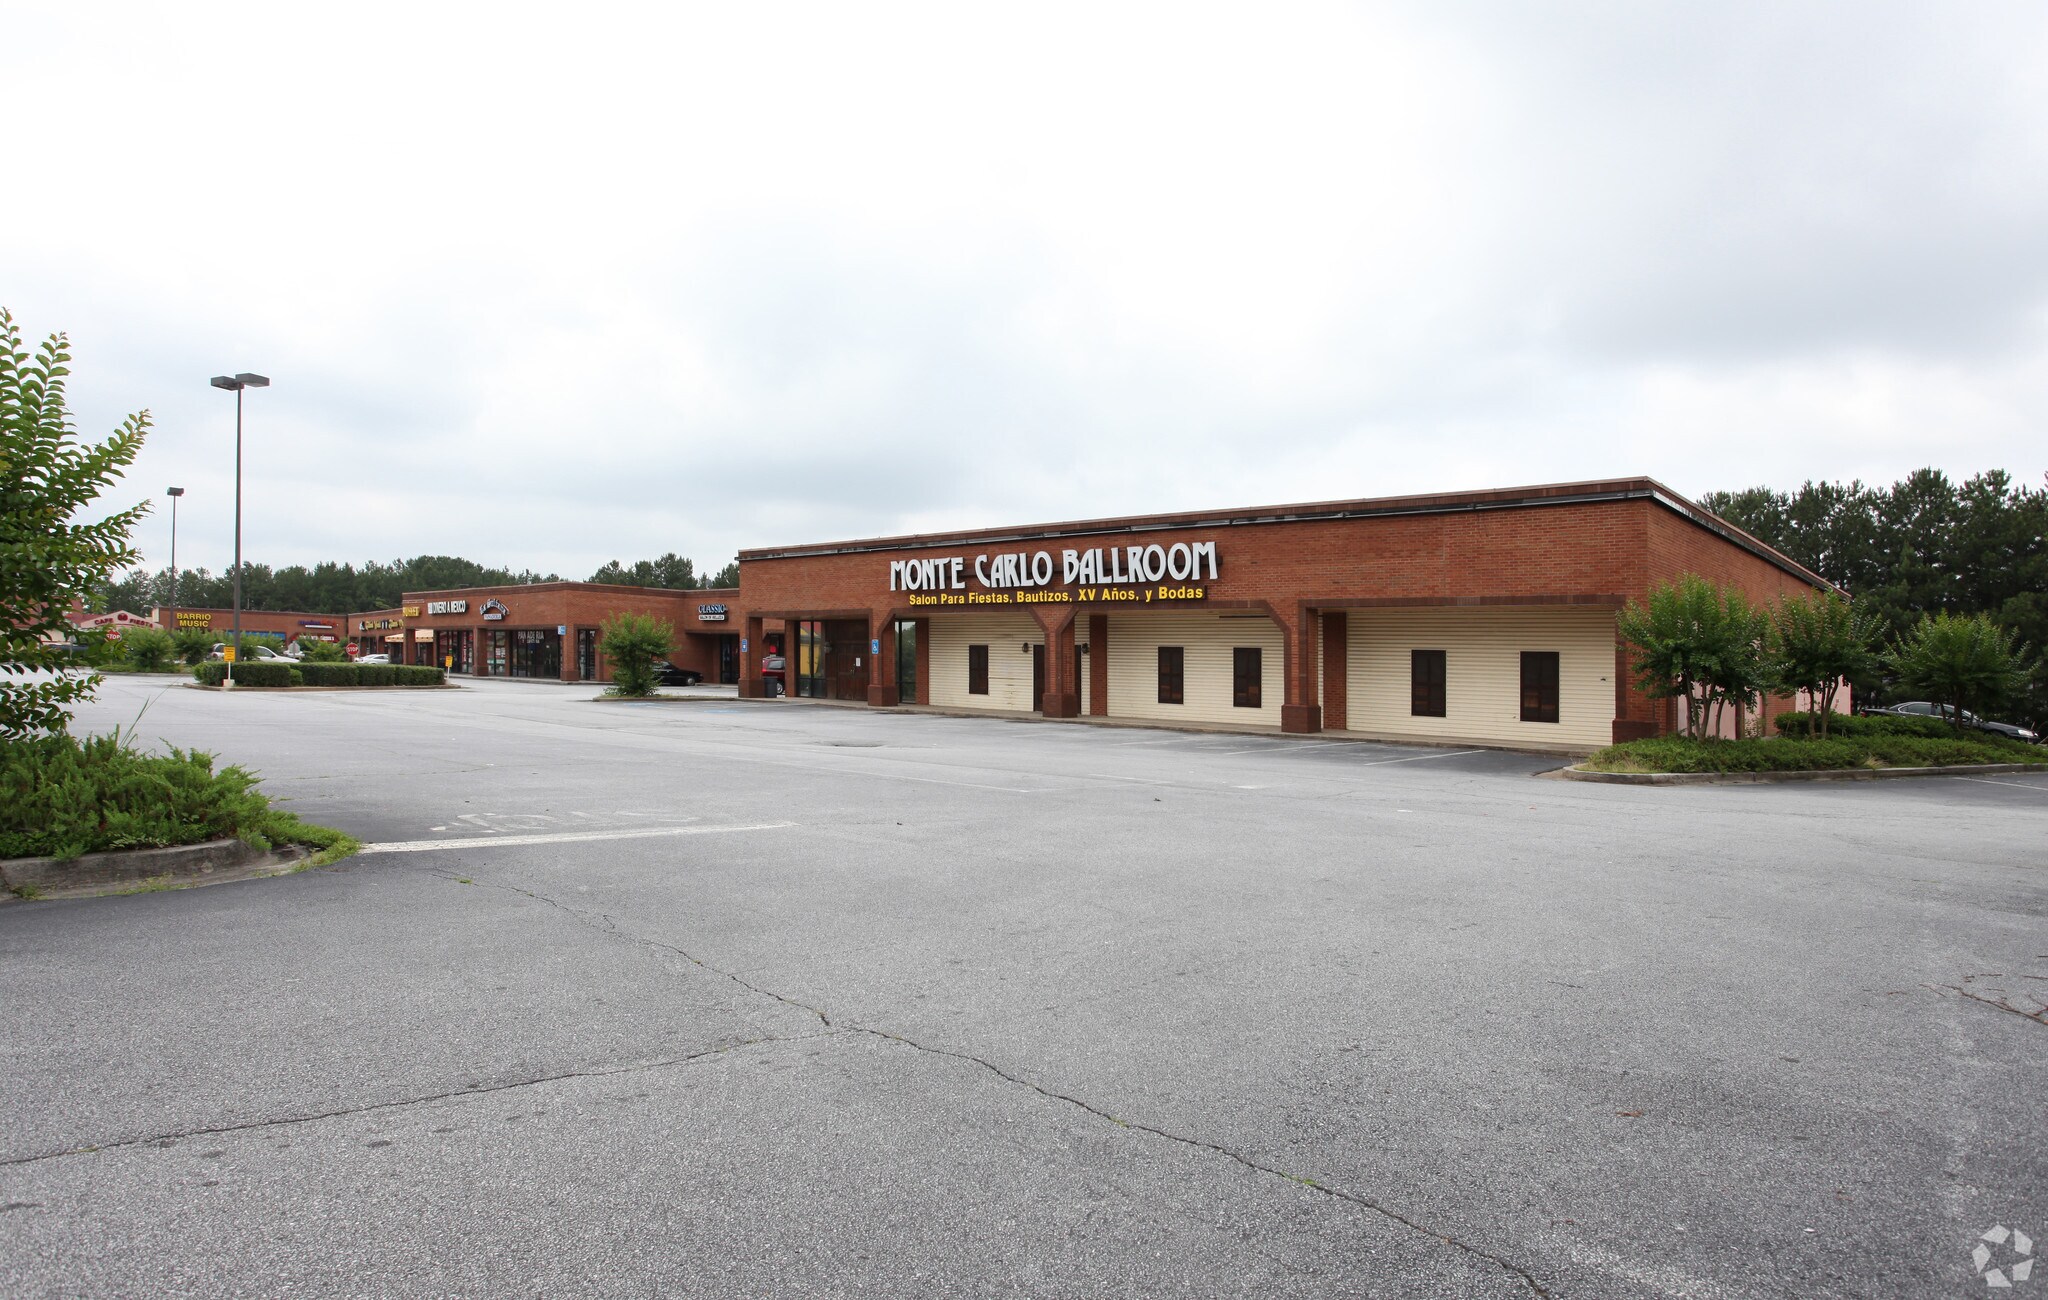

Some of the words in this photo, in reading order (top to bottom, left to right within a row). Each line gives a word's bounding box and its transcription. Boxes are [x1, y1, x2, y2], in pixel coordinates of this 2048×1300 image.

[889, 556, 966, 592] MONTE
[975, 550, 1053, 588] CARLO
[1062, 541, 1219, 585] BALLROOM
[909, 594, 938, 605] Salon
[940, 593, 965, 605] Para
[968, 592, 1013, 604] Fiestas,
[1016, 590, 1073, 603] Bautizos,
[1078, 588, 1097, 601] XV
[1101, 587, 1140, 601] Años,
[1145, 590, 1153, 602] y
[1158, 585, 1204, 599] Bodas
[176, 612, 212, 621] BARRIO
[179, 620, 209, 628] MUSIC
